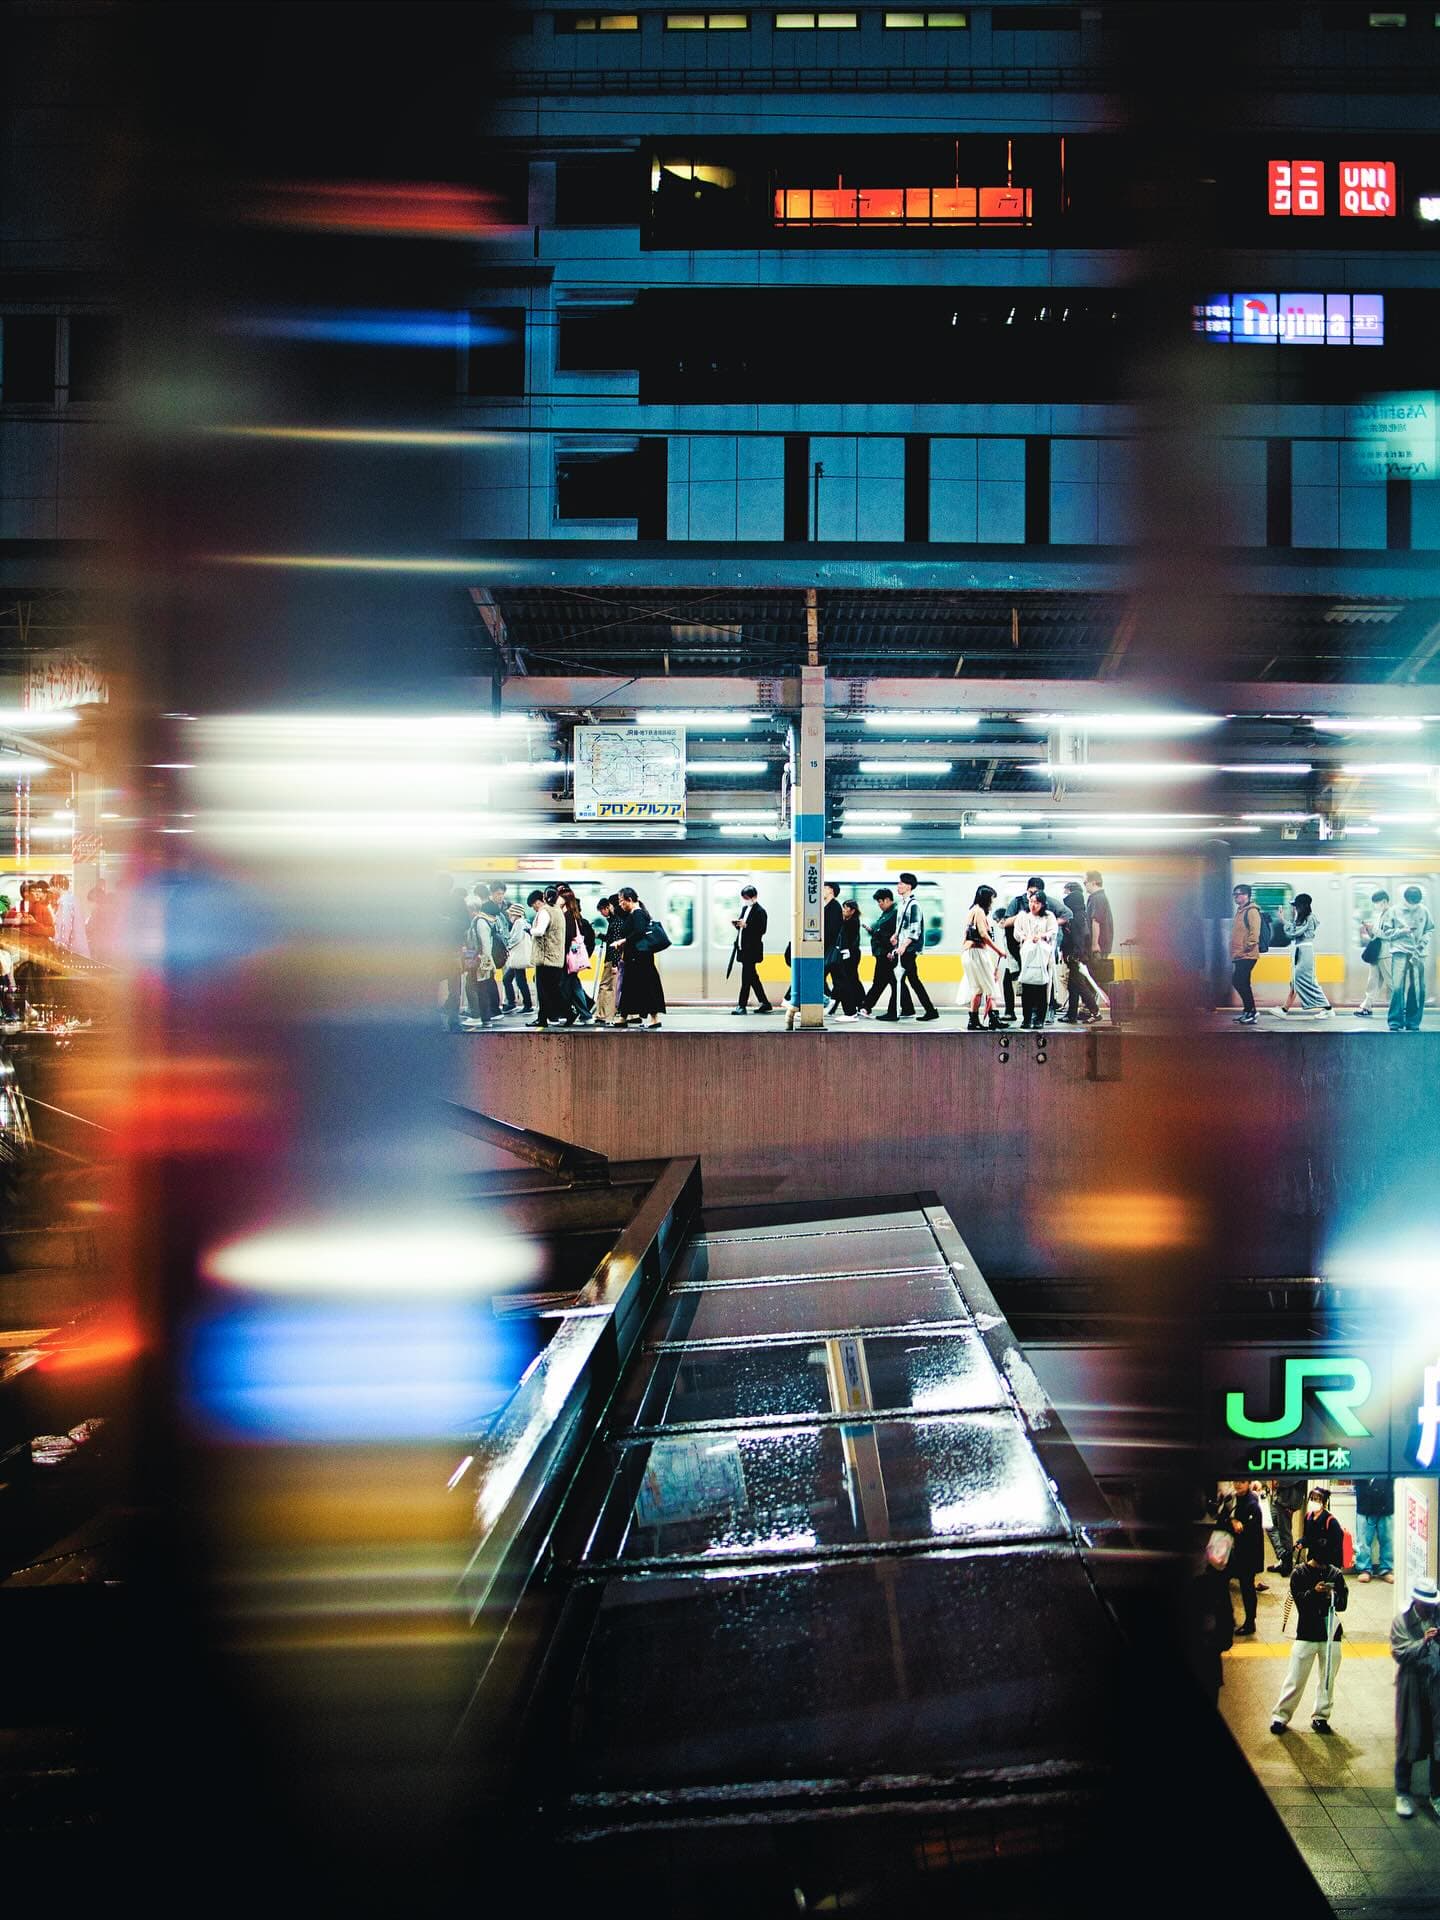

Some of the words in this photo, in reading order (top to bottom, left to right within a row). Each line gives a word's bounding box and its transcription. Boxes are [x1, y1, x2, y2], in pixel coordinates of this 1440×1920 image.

[1344, 168, 1386, 188] UNI
[1344, 190, 1390, 213] QLO
[810, 760, 818, 768] 15
[807, 866, 818, 904] ふなばし
[1226, 1358, 1374, 1439] JR
[1248, 1448, 1351, 1472] JR東日本
